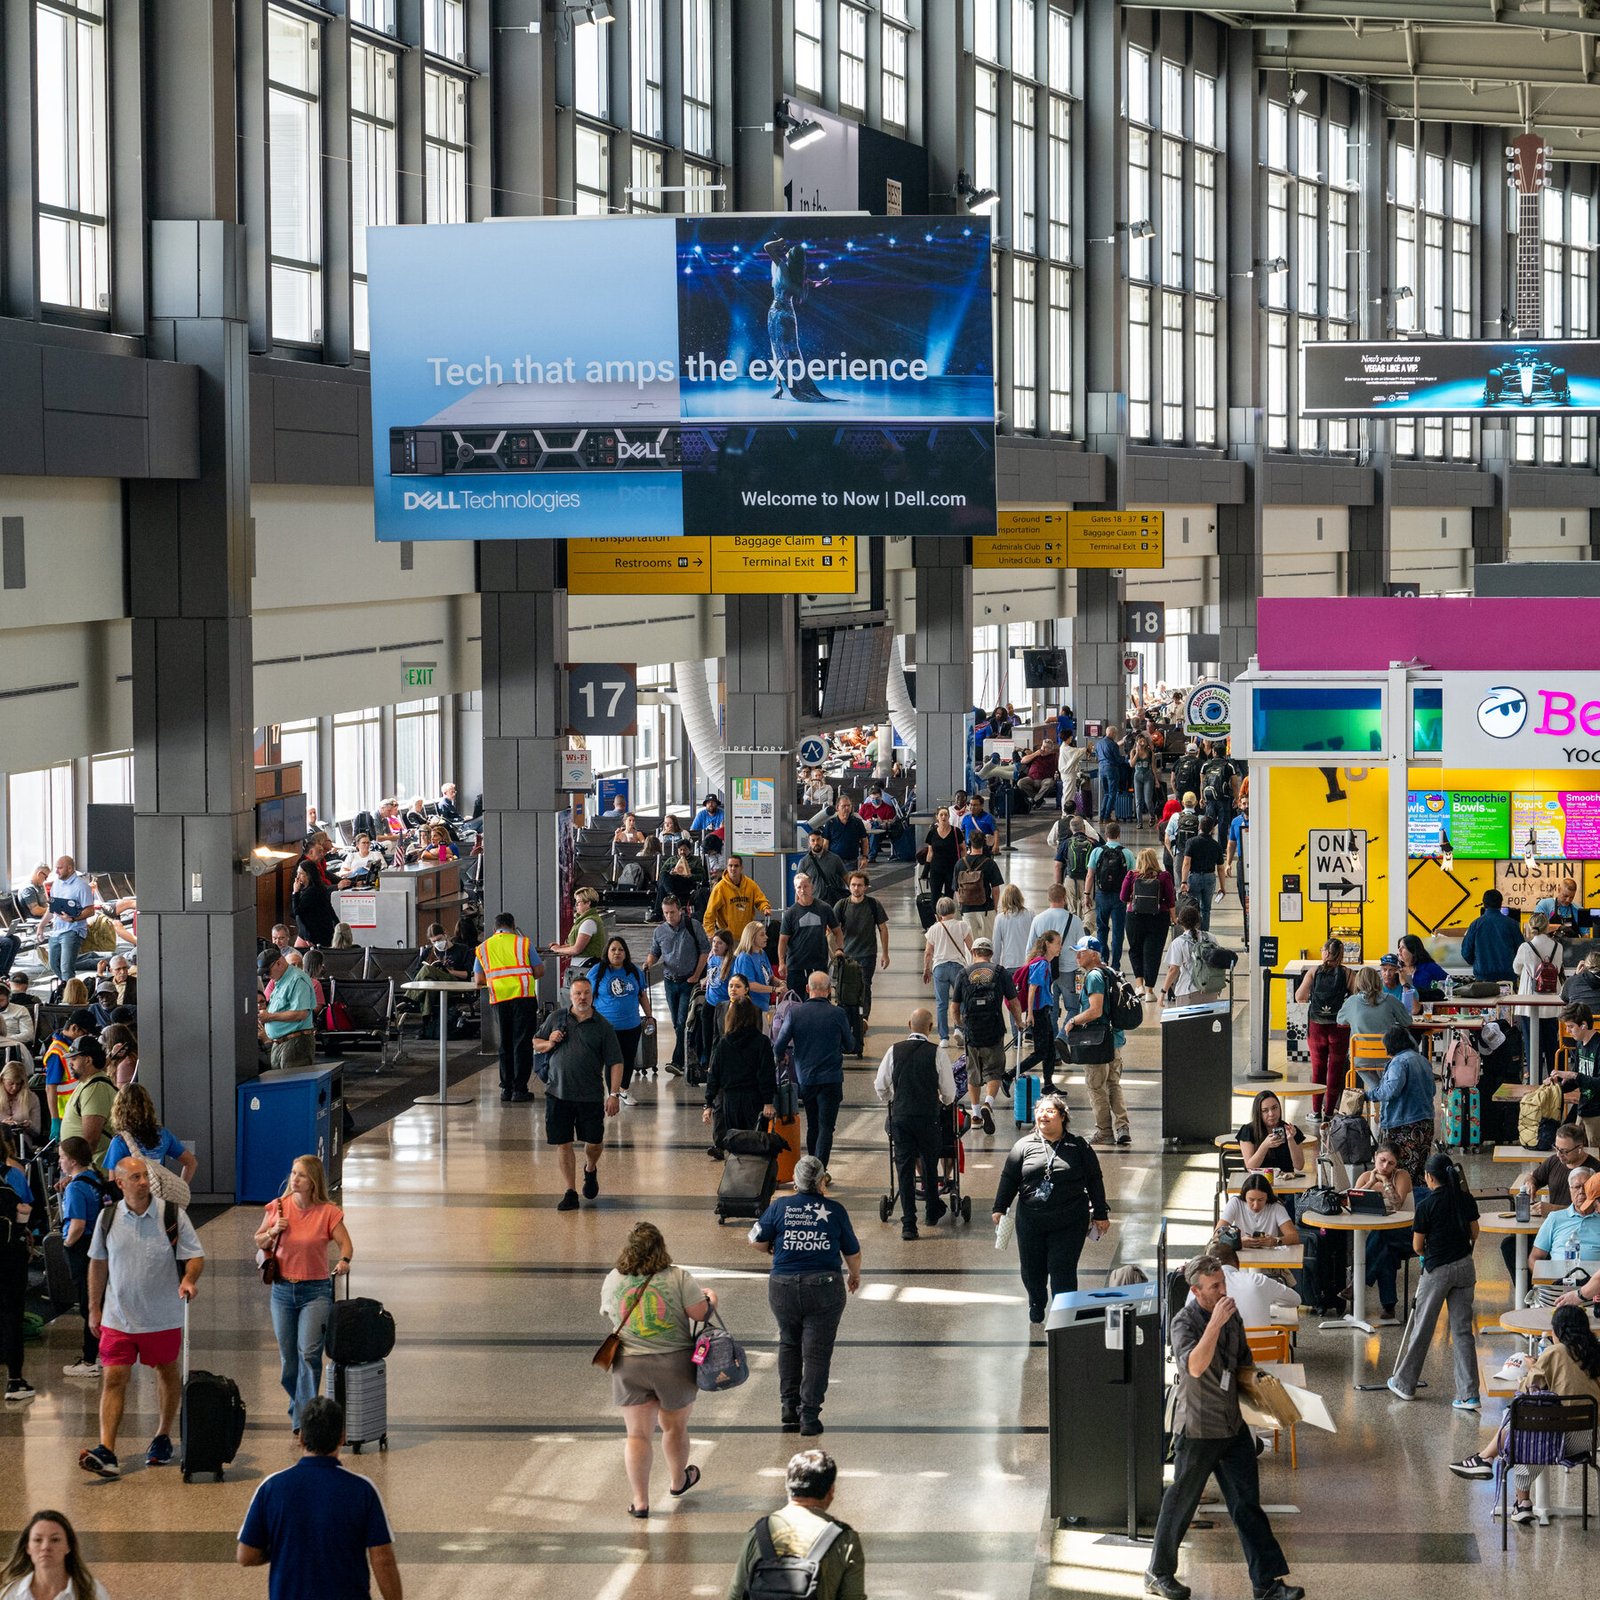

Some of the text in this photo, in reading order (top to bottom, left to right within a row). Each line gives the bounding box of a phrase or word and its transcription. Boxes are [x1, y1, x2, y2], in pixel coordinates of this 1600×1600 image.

[428, 352, 928, 393] Tech that amps the experience
[1364, 364, 1386, 372] VEGAS
[1386, 364, 1400, 372] LIKE
[1401, 364, 1407, 372] A
[618, 441, 666, 460] DELL
[404, 490, 580, 512] DELL Technologies
[741, 491, 818, 508] Welcome
[822, 492, 840, 508] to
[844, 492, 880, 508] Now
[894, 490, 967, 508] Dell.com
[1083, 529, 1137, 538] Baggage Claim
[734, 536, 815, 548] Baggage Claim
[992, 543, 1040, 551] Admirals Club
[615, 558, 672, 568] Restrooms
[743, 556, 815, 567] Terminal Exit
[998, 556, 1040, 564] United Club
[1131, 612, 1158, 634] 18
[409, 668, 434, 686] EXIT
[578, 681, 626, 718] 17
[272, 724, 281, 744] 17
[1452, 793, 1507, 803] Smoothie
[1452, 803, 1485, 812] Bowls
[1514, 801, 1542, 810] Yogurt
[1318, 835, 1358, 852] ON
[1505, 862, 1574, 878] AUSTIN
[1512, 884, 1534, 892] CITY
[784, 1219, 818, 1227] Lagardère
[783, 1230, 828, 1241] PEOPLE
[782, 1240, 831, 1251] STRONG
